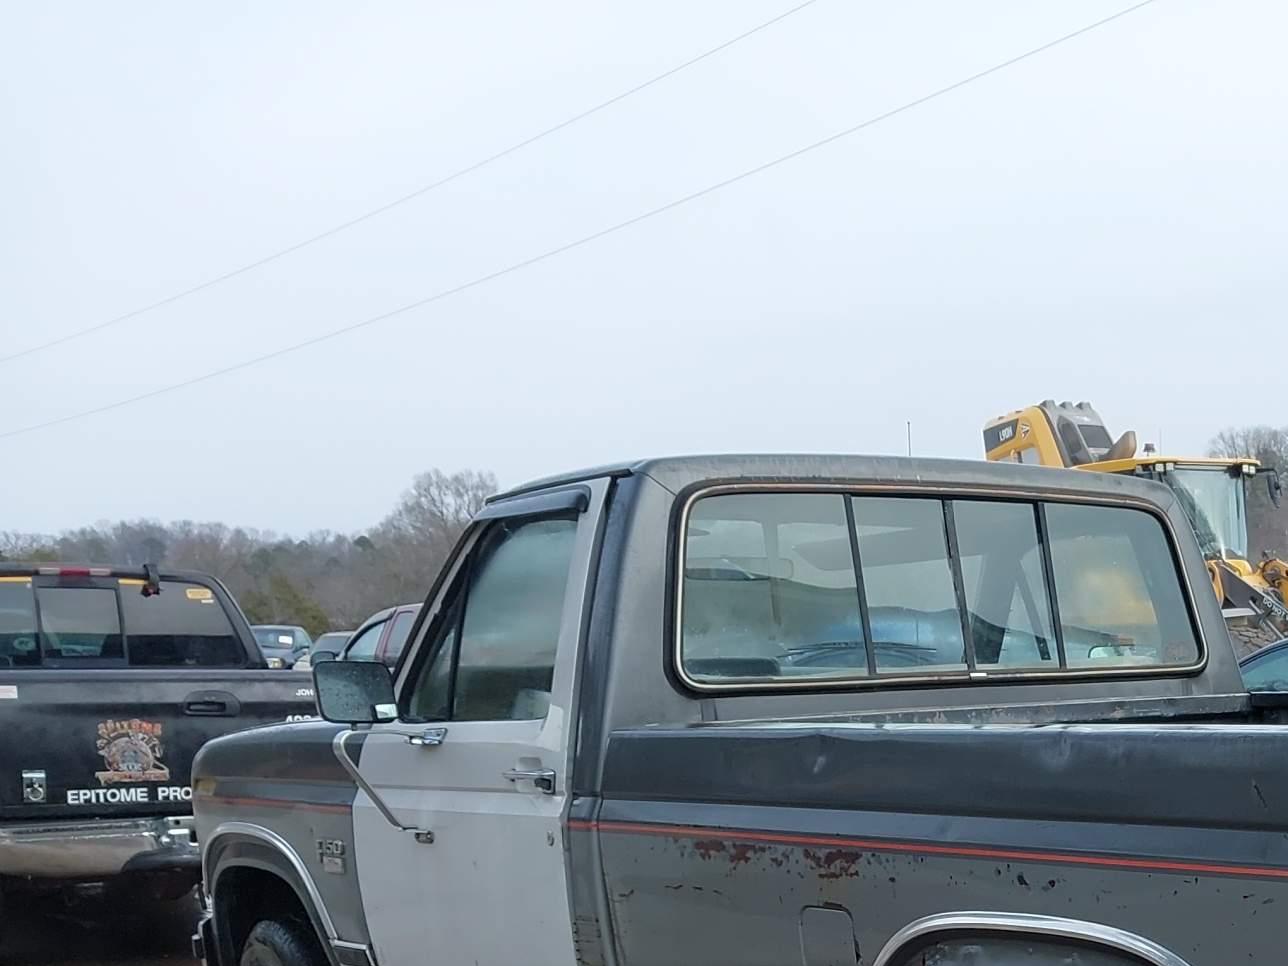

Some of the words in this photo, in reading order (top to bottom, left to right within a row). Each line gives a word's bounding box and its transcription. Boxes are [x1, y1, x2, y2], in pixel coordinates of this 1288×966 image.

[1263, 597, 1272, 608] DO
[1272, 605, 1285, 617] NOT
[67, 787, 148, 804] EPITOME
[157, 786, 192, 801] PRO
